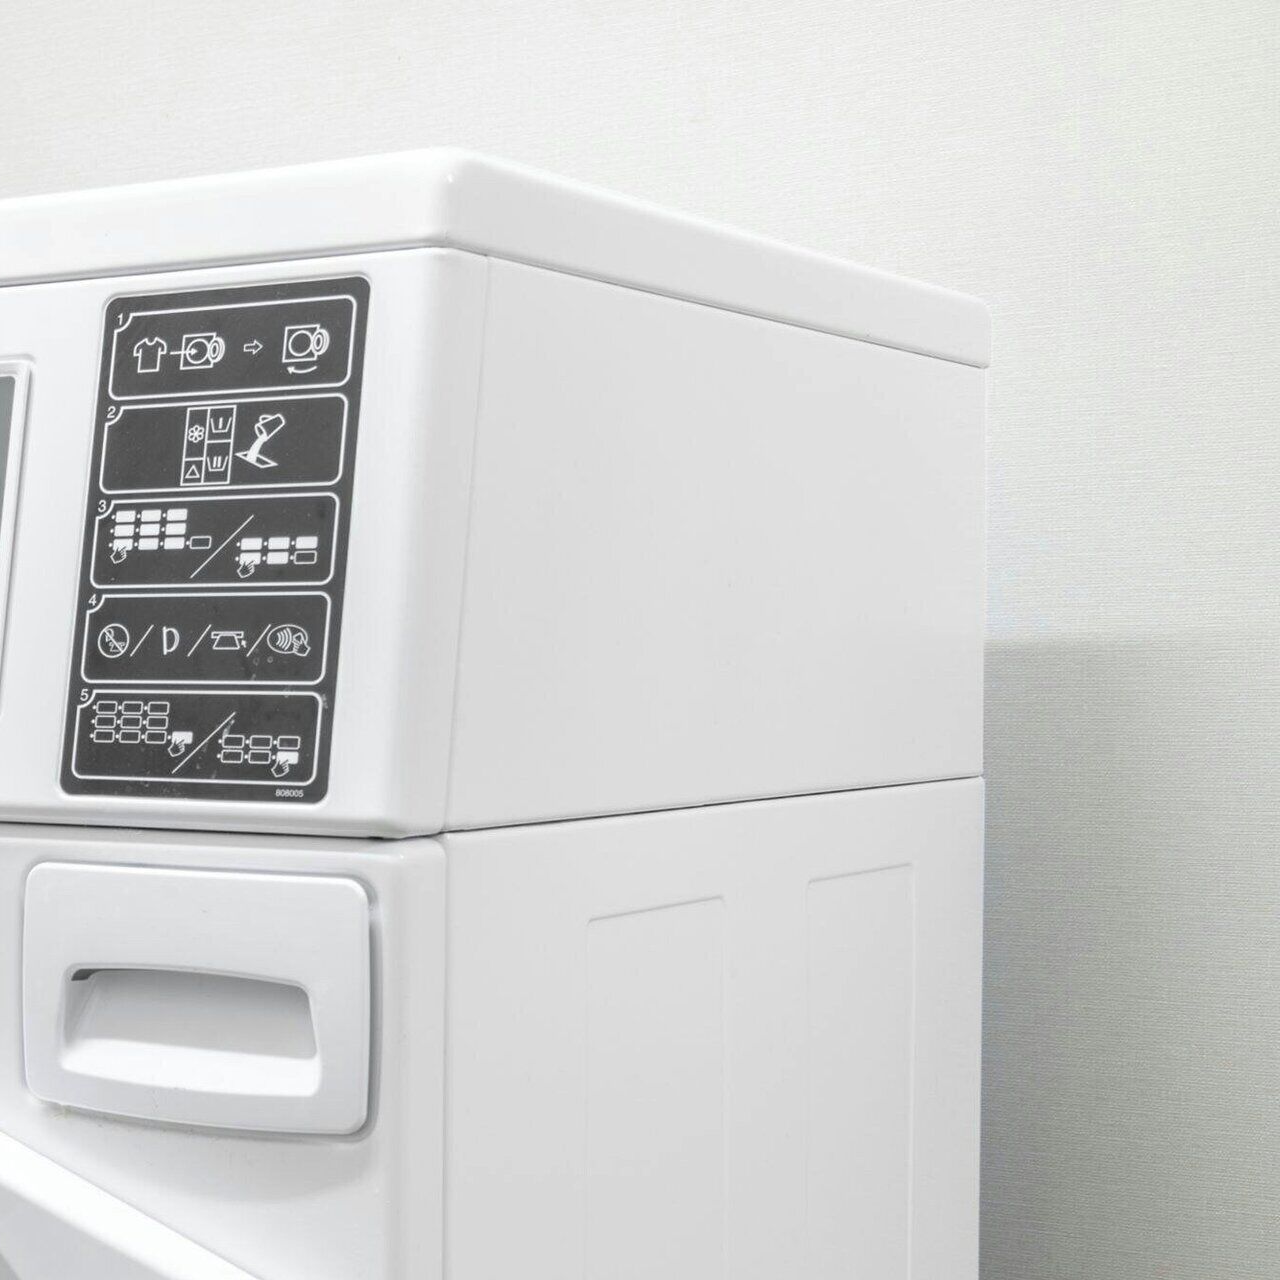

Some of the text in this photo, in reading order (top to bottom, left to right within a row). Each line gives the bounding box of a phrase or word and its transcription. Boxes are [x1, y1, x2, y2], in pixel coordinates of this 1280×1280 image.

[117, 313, 124, 325] 1
[107, 405, 116, 418] 2
[97, 500, 106, 512] 3
[89, 594, 97, 606] 4
[80, 688, 88, 701] 5
